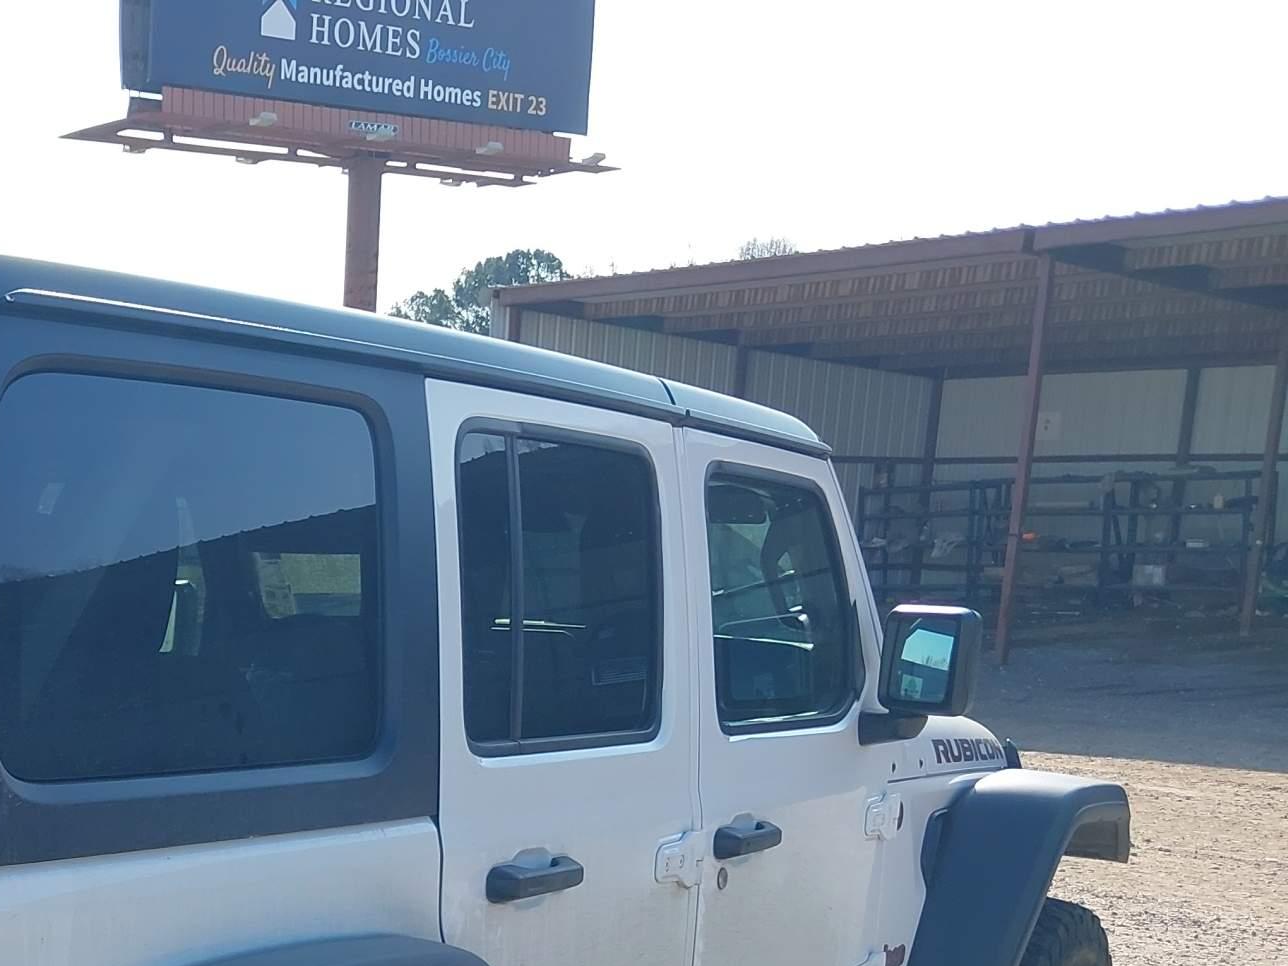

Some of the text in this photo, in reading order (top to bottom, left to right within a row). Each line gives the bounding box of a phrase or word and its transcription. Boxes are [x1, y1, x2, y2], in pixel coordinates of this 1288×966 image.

[308, 13, 421, 59] HOMES
[213, 45, 547, 116] Quality Manufactured Homes EXIT 23
[425, 37, 510, 82] Bossier City
[931, 738, 1004, 765] RUBICON
